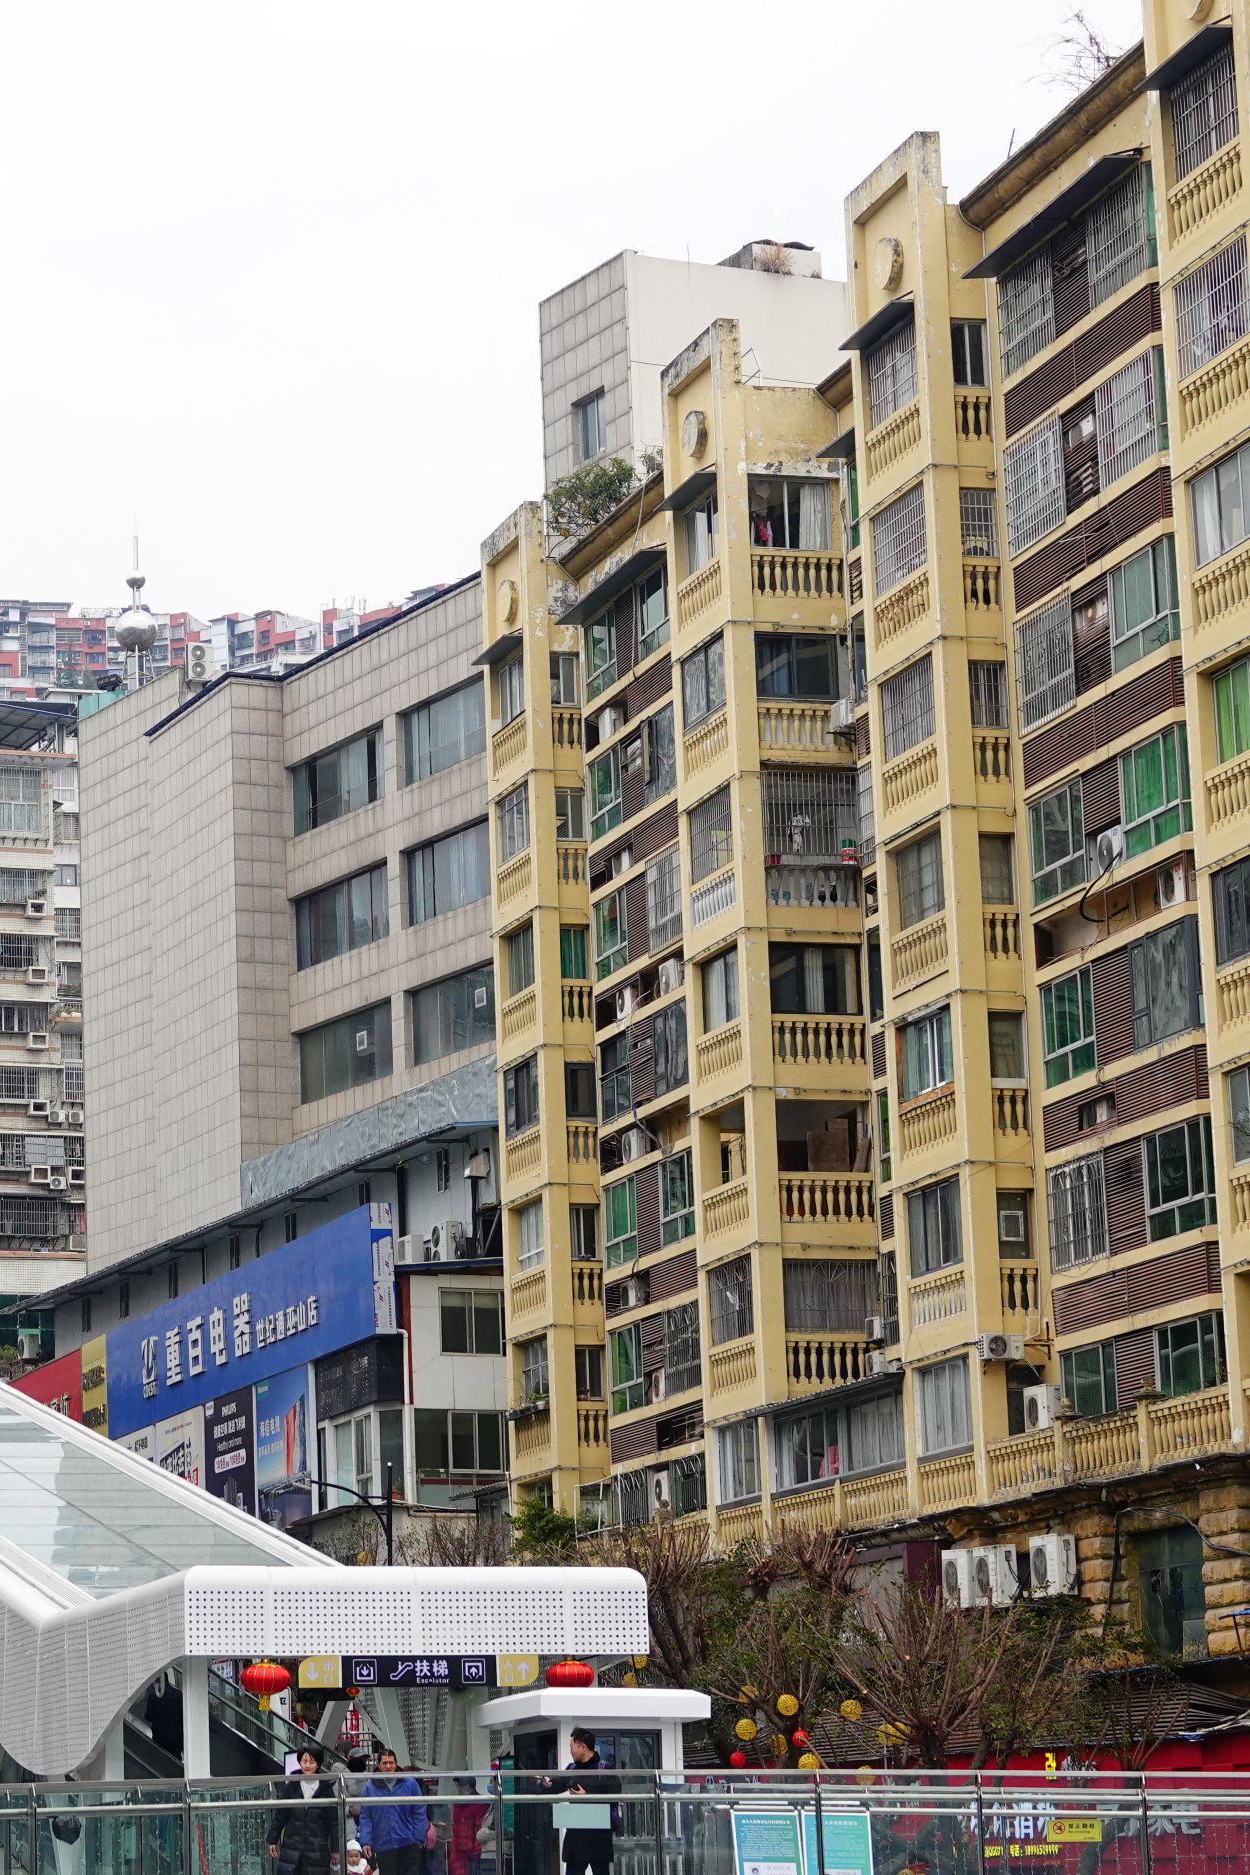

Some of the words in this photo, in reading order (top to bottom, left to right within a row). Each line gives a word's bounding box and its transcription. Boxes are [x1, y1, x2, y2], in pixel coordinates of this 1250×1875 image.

[165, 1293, 252, 1387] 重百电器
[256, 1295, 319, 1348] 世纪通巫山店
[414, 1659, 449, 1677] 扶梯
